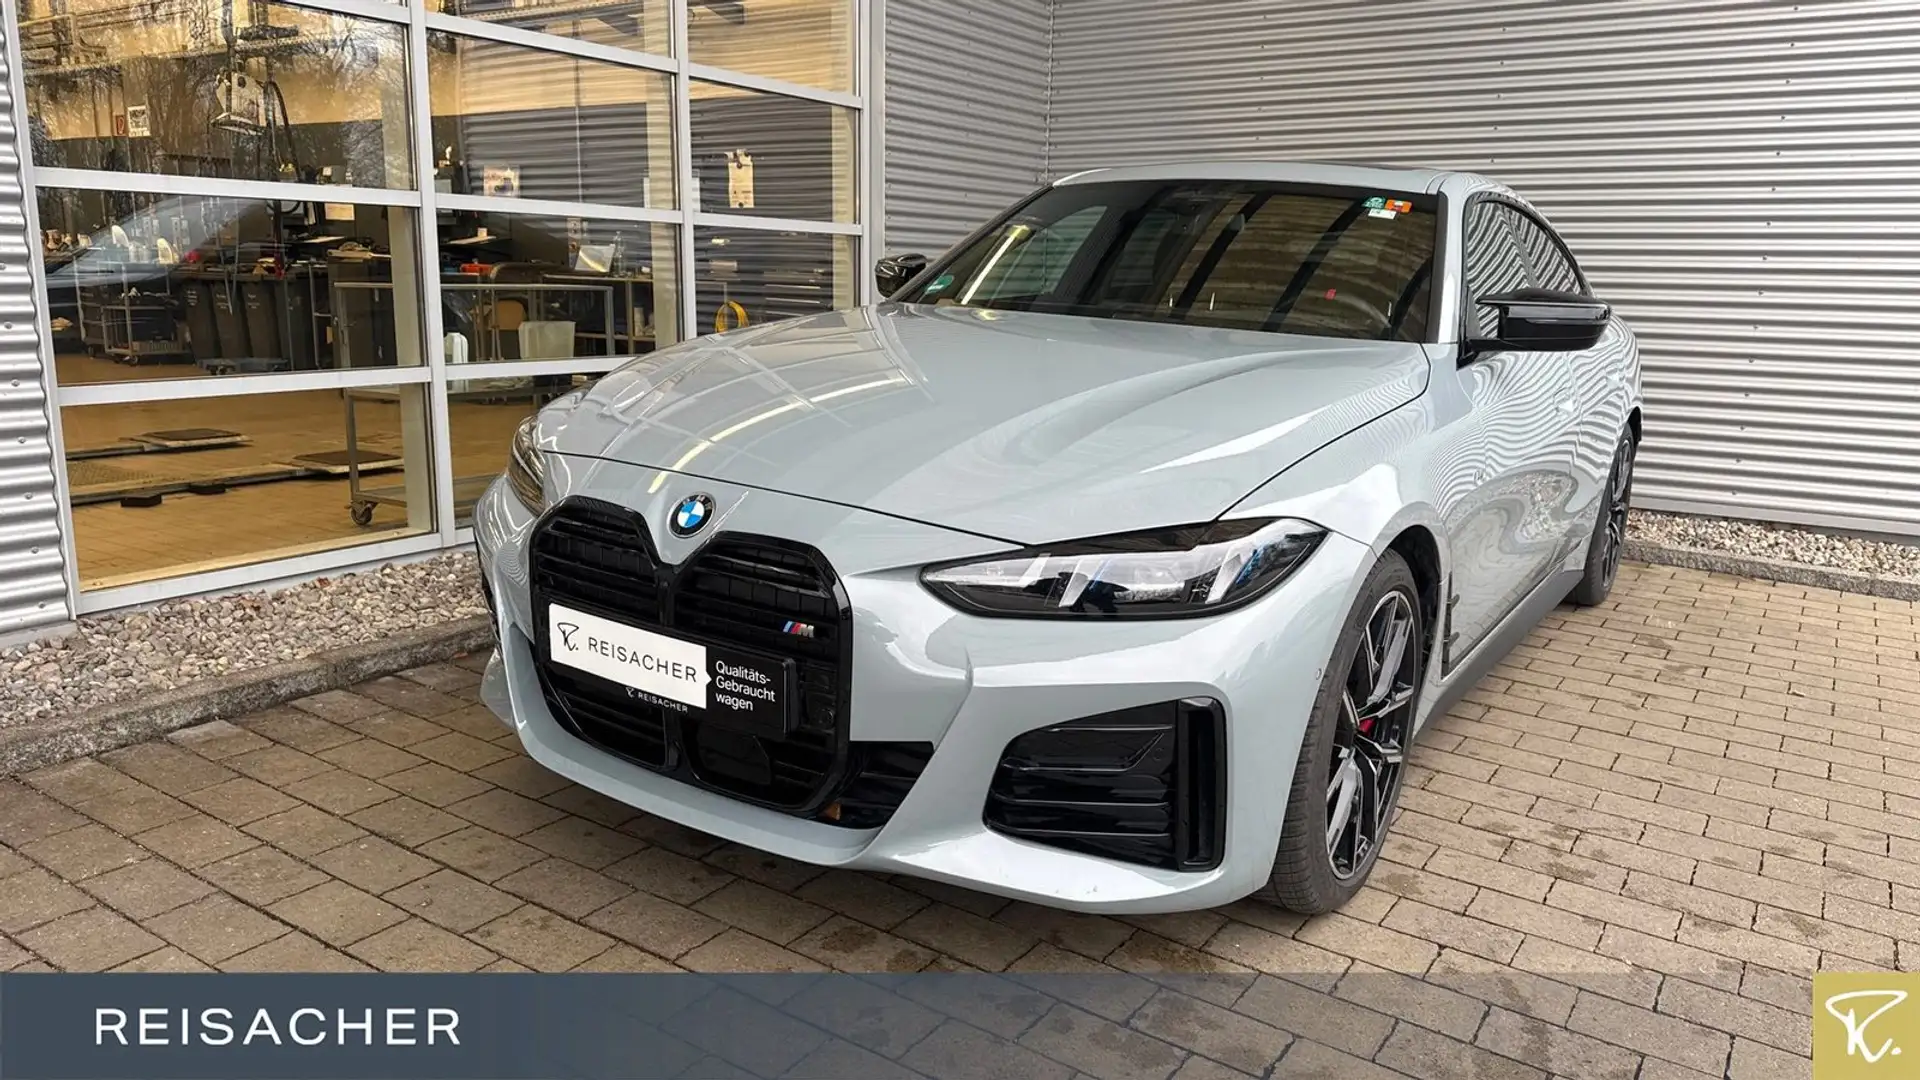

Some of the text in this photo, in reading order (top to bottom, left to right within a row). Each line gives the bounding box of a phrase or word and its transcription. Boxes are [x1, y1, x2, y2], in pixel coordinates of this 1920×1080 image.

[588, 636, 697, 683] REISACHER
[715, 660, 772, 685] Qualitäts-
[715, 675, 776, 703] Gebraucht
[715, 692, 754, 711] wagen
[637, 691, 688, 713] REISACHER
